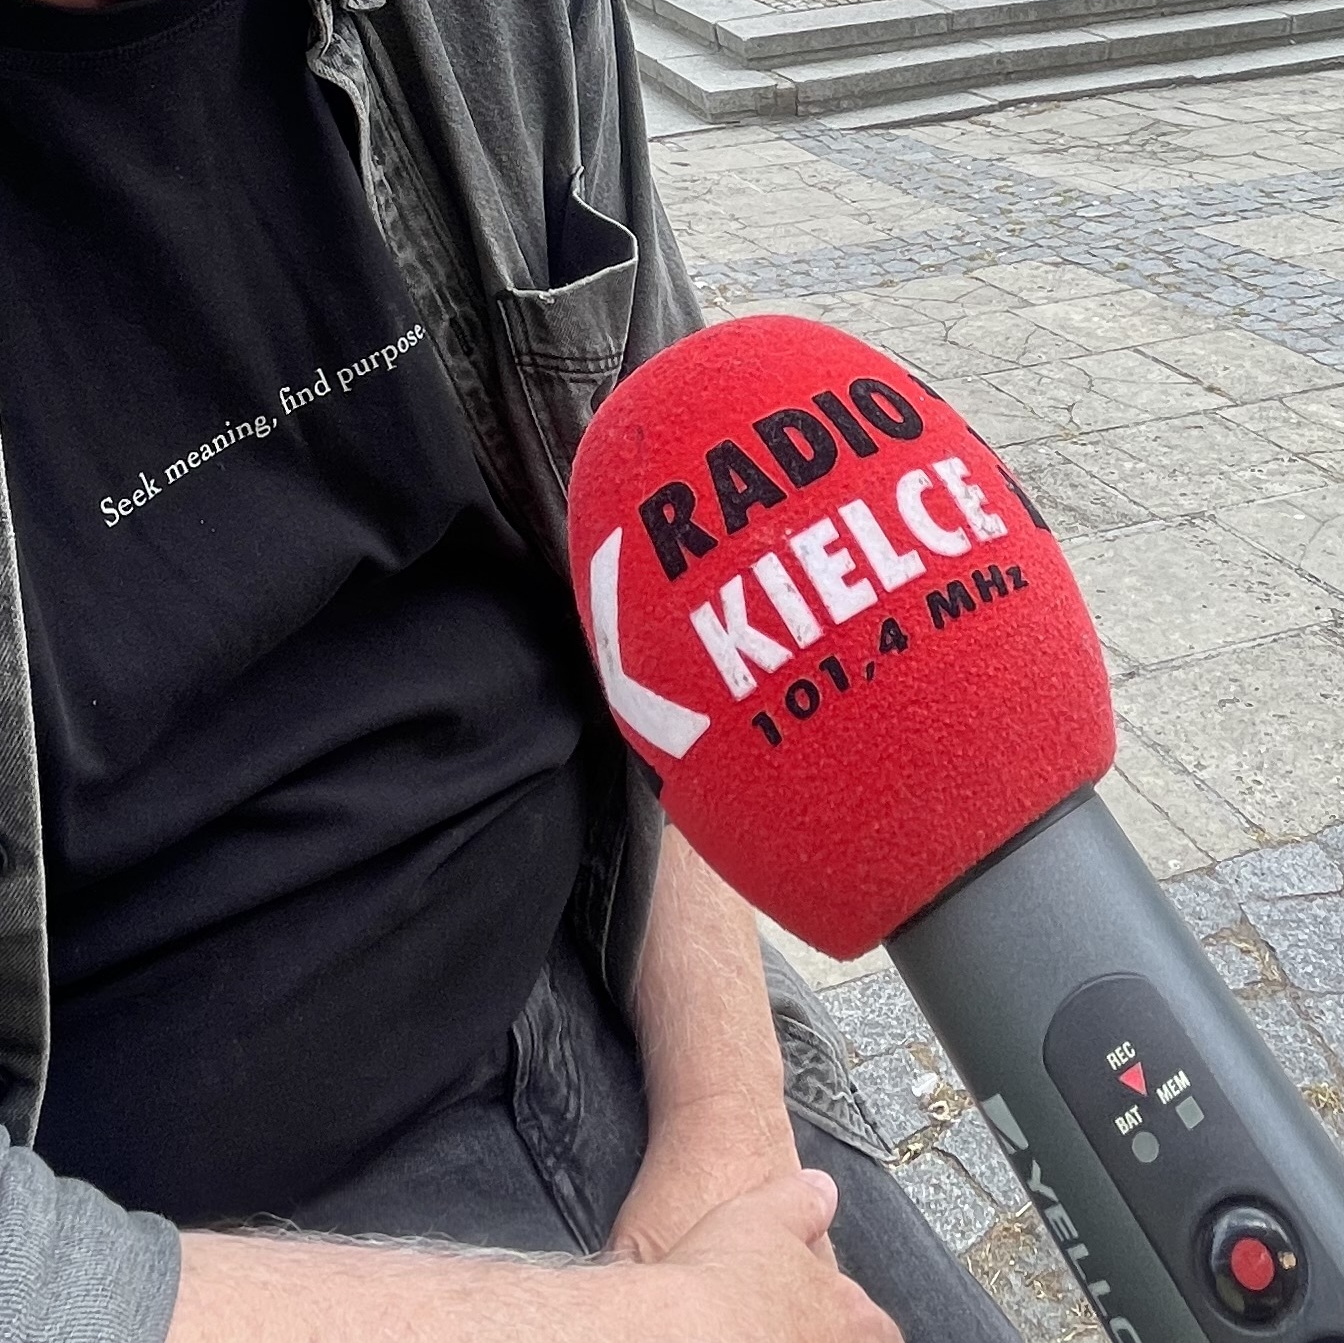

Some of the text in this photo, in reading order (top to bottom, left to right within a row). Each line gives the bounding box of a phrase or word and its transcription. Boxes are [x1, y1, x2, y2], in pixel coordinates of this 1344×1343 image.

[100, 471, 163, 528] Seek
[164, 414, 278, 485] meaning,
[278, 368, 332, 415] find
[638, 378, 925, 582] RADIO
[689, 457, 1008, 701] KIELCE
[751, 564, 1029, 737] 101,4 MHz
[1106, 1041, 1136, 1071] REC
[1114, 1104, 1144, 1136] BAT
[1156, 1070, 1191, 1105] MEM
